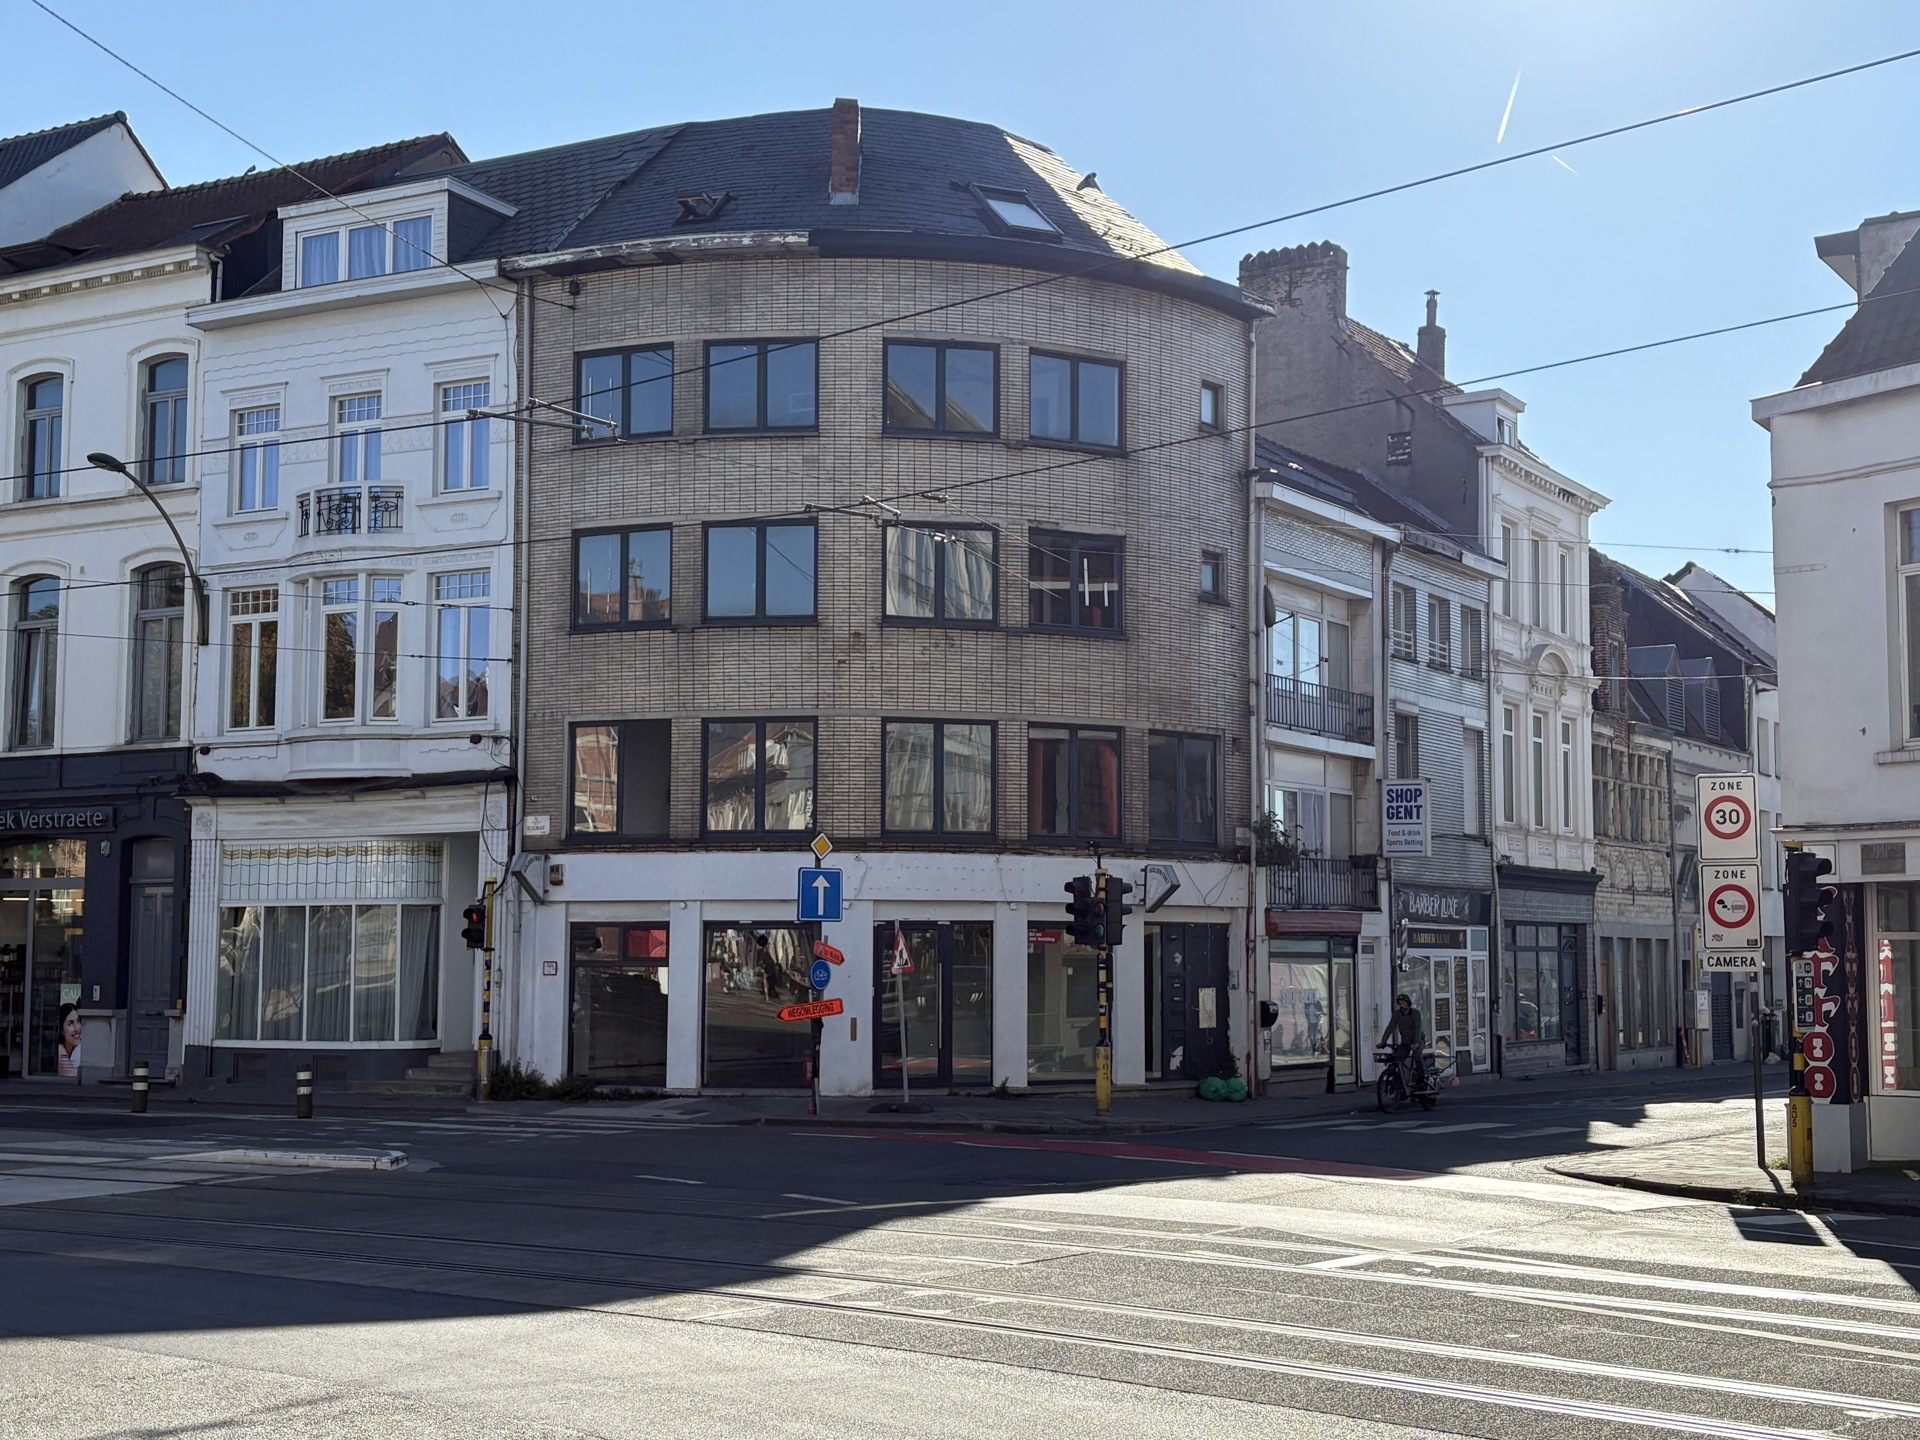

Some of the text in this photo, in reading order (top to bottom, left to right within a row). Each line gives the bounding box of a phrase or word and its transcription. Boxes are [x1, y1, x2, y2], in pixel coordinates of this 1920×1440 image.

[1710, 781, 1743, 791] ZONE
[1386, 788, 1423, 804] SHOP
[1386, 804, 1423, 820] GENT
[1715, 808, 1741, 825] 30
[19, 810, 103, 829] Verstraete
[1387, 829, 1401, 837] Food
[1386, 839, 1424, 847] Sports Betting
[1714, 869, 1746, 880] ZONE
[1409, 892, 1460, 919] BARBER LUXE
[1412, 932, 1451, 944] BARBER LUXE
[1707, 956, 1757, 968] CAMERA
[787, 1002, 835, 1018] WEGOMLEGGING
